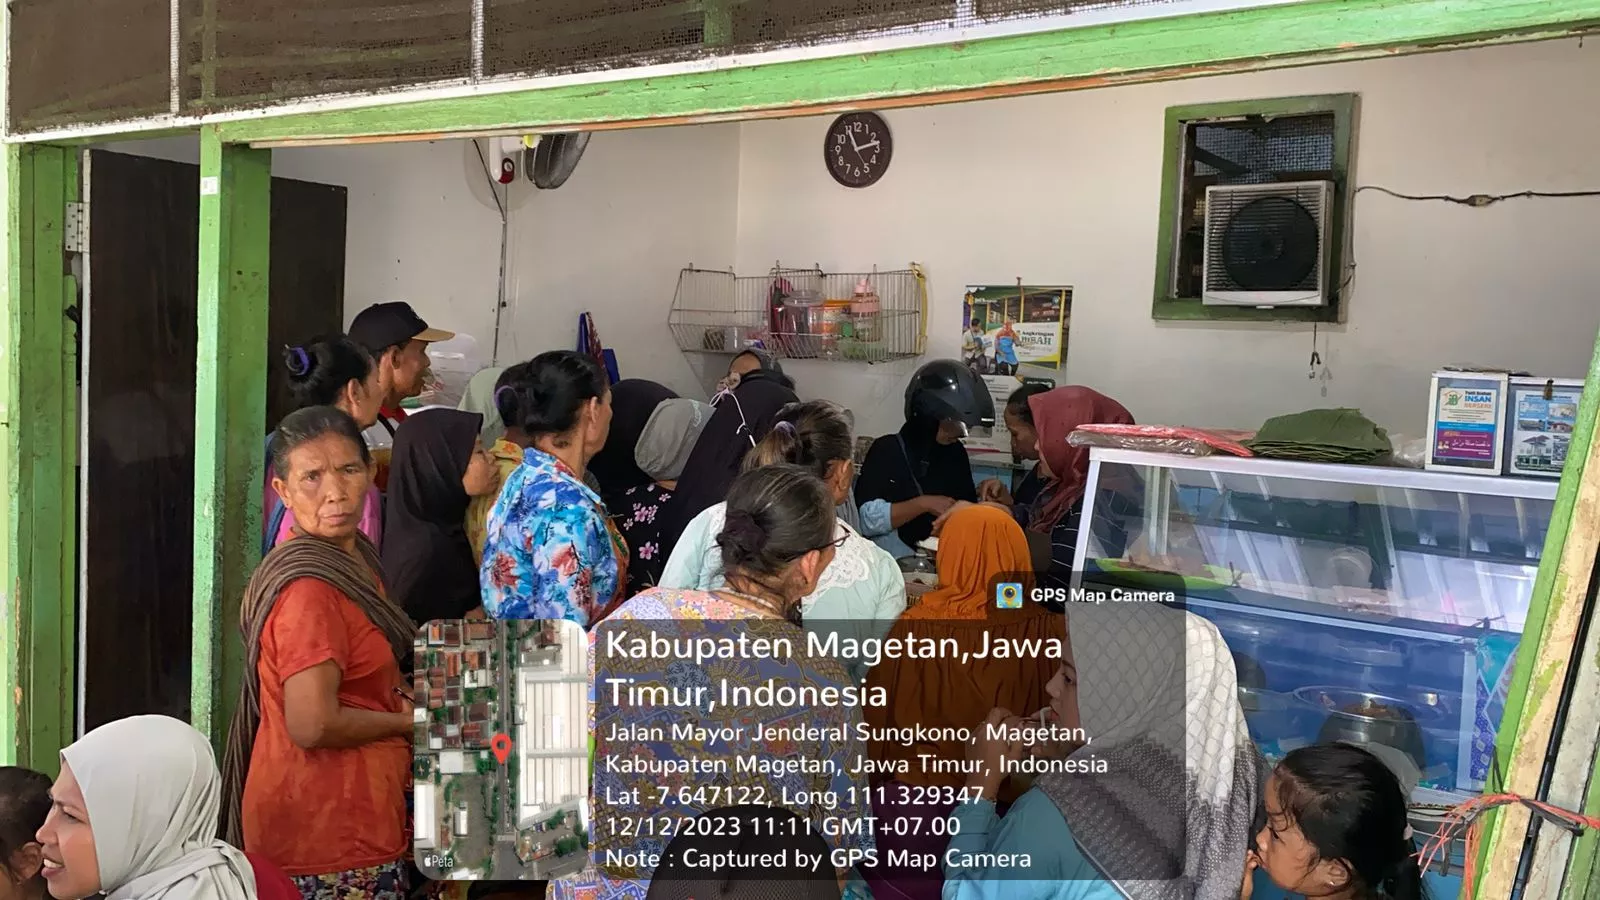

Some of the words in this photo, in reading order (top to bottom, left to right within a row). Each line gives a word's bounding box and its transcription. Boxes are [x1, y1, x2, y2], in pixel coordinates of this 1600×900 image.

[853, 121, 862, 132] 12
[865, 124, 869, 134] 1
[837, 134, 846, 144] 10
[870, 132, 877, 143] 2
[835, 145, 841, 155] 9
[838, 156, 844, 166] 8
[870, 154, 877, 164] 4
[845, 163, 851, 174] 7
[854, 167, 861, 177] 6
[863, 163, 870, 173] 5
